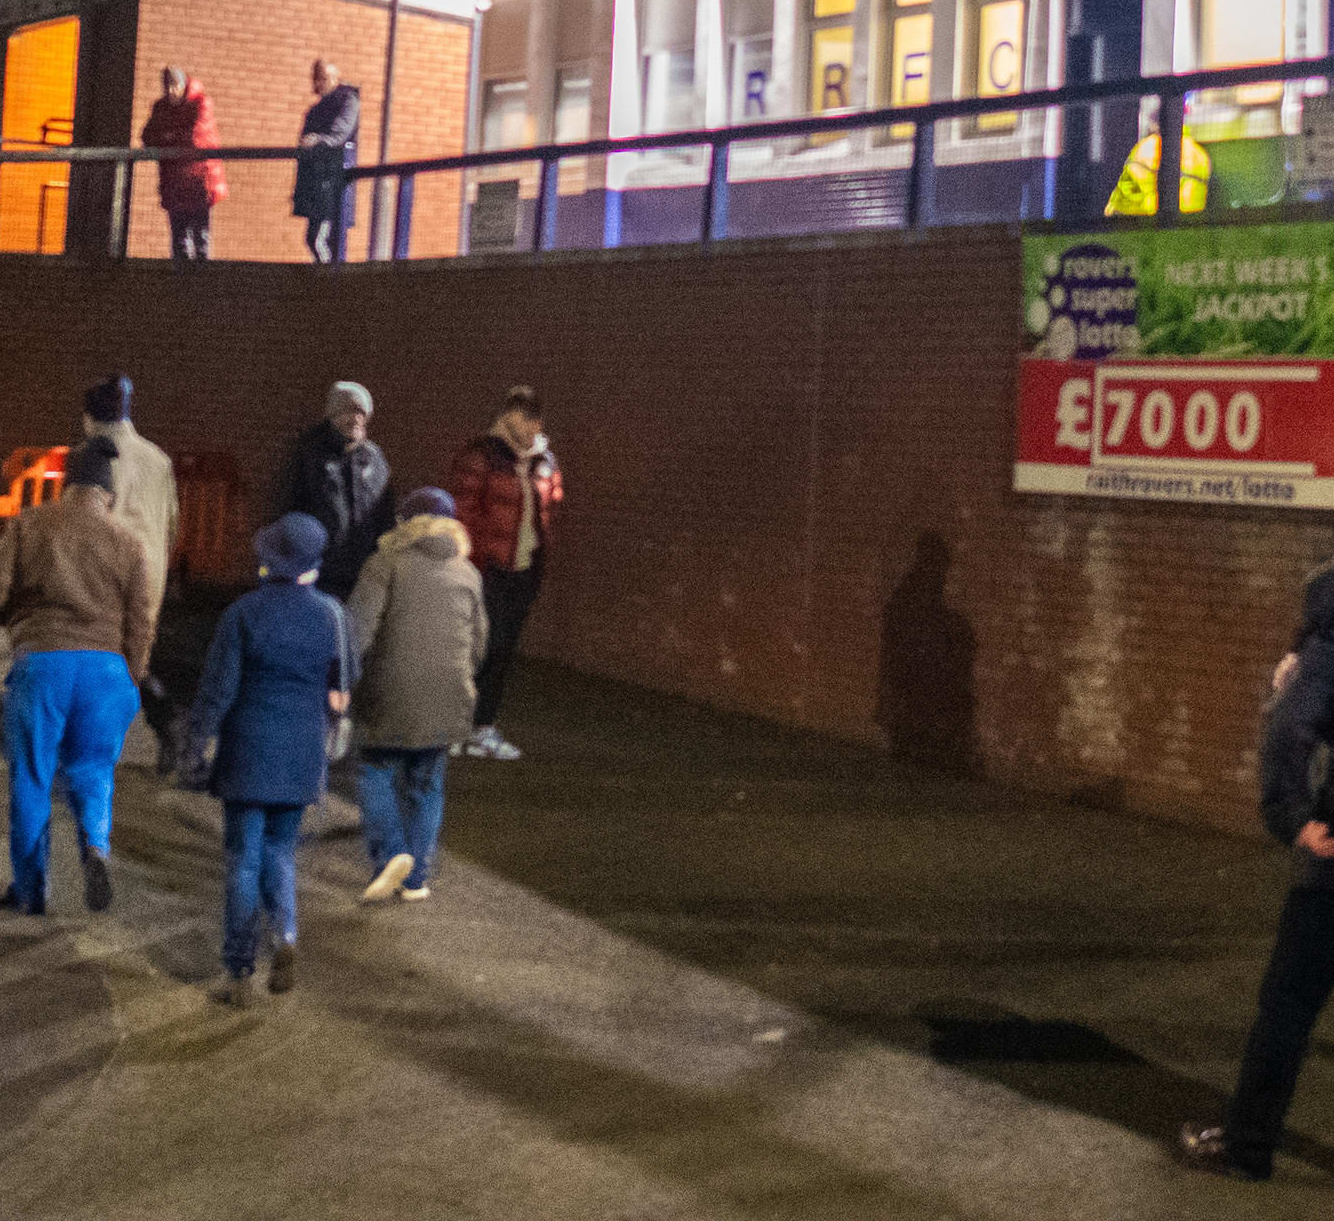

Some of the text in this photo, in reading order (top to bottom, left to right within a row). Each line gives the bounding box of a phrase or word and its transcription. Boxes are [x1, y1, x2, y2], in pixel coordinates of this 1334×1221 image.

[1063, 257, 1139, 279] rovers
[1166, 260, 1227, 288] NEXT
[1070, 288, 1139, 316] super
[1191, 291, 1310, 323] JACKPOT
[1078, 318, 1141, 349] lotto
